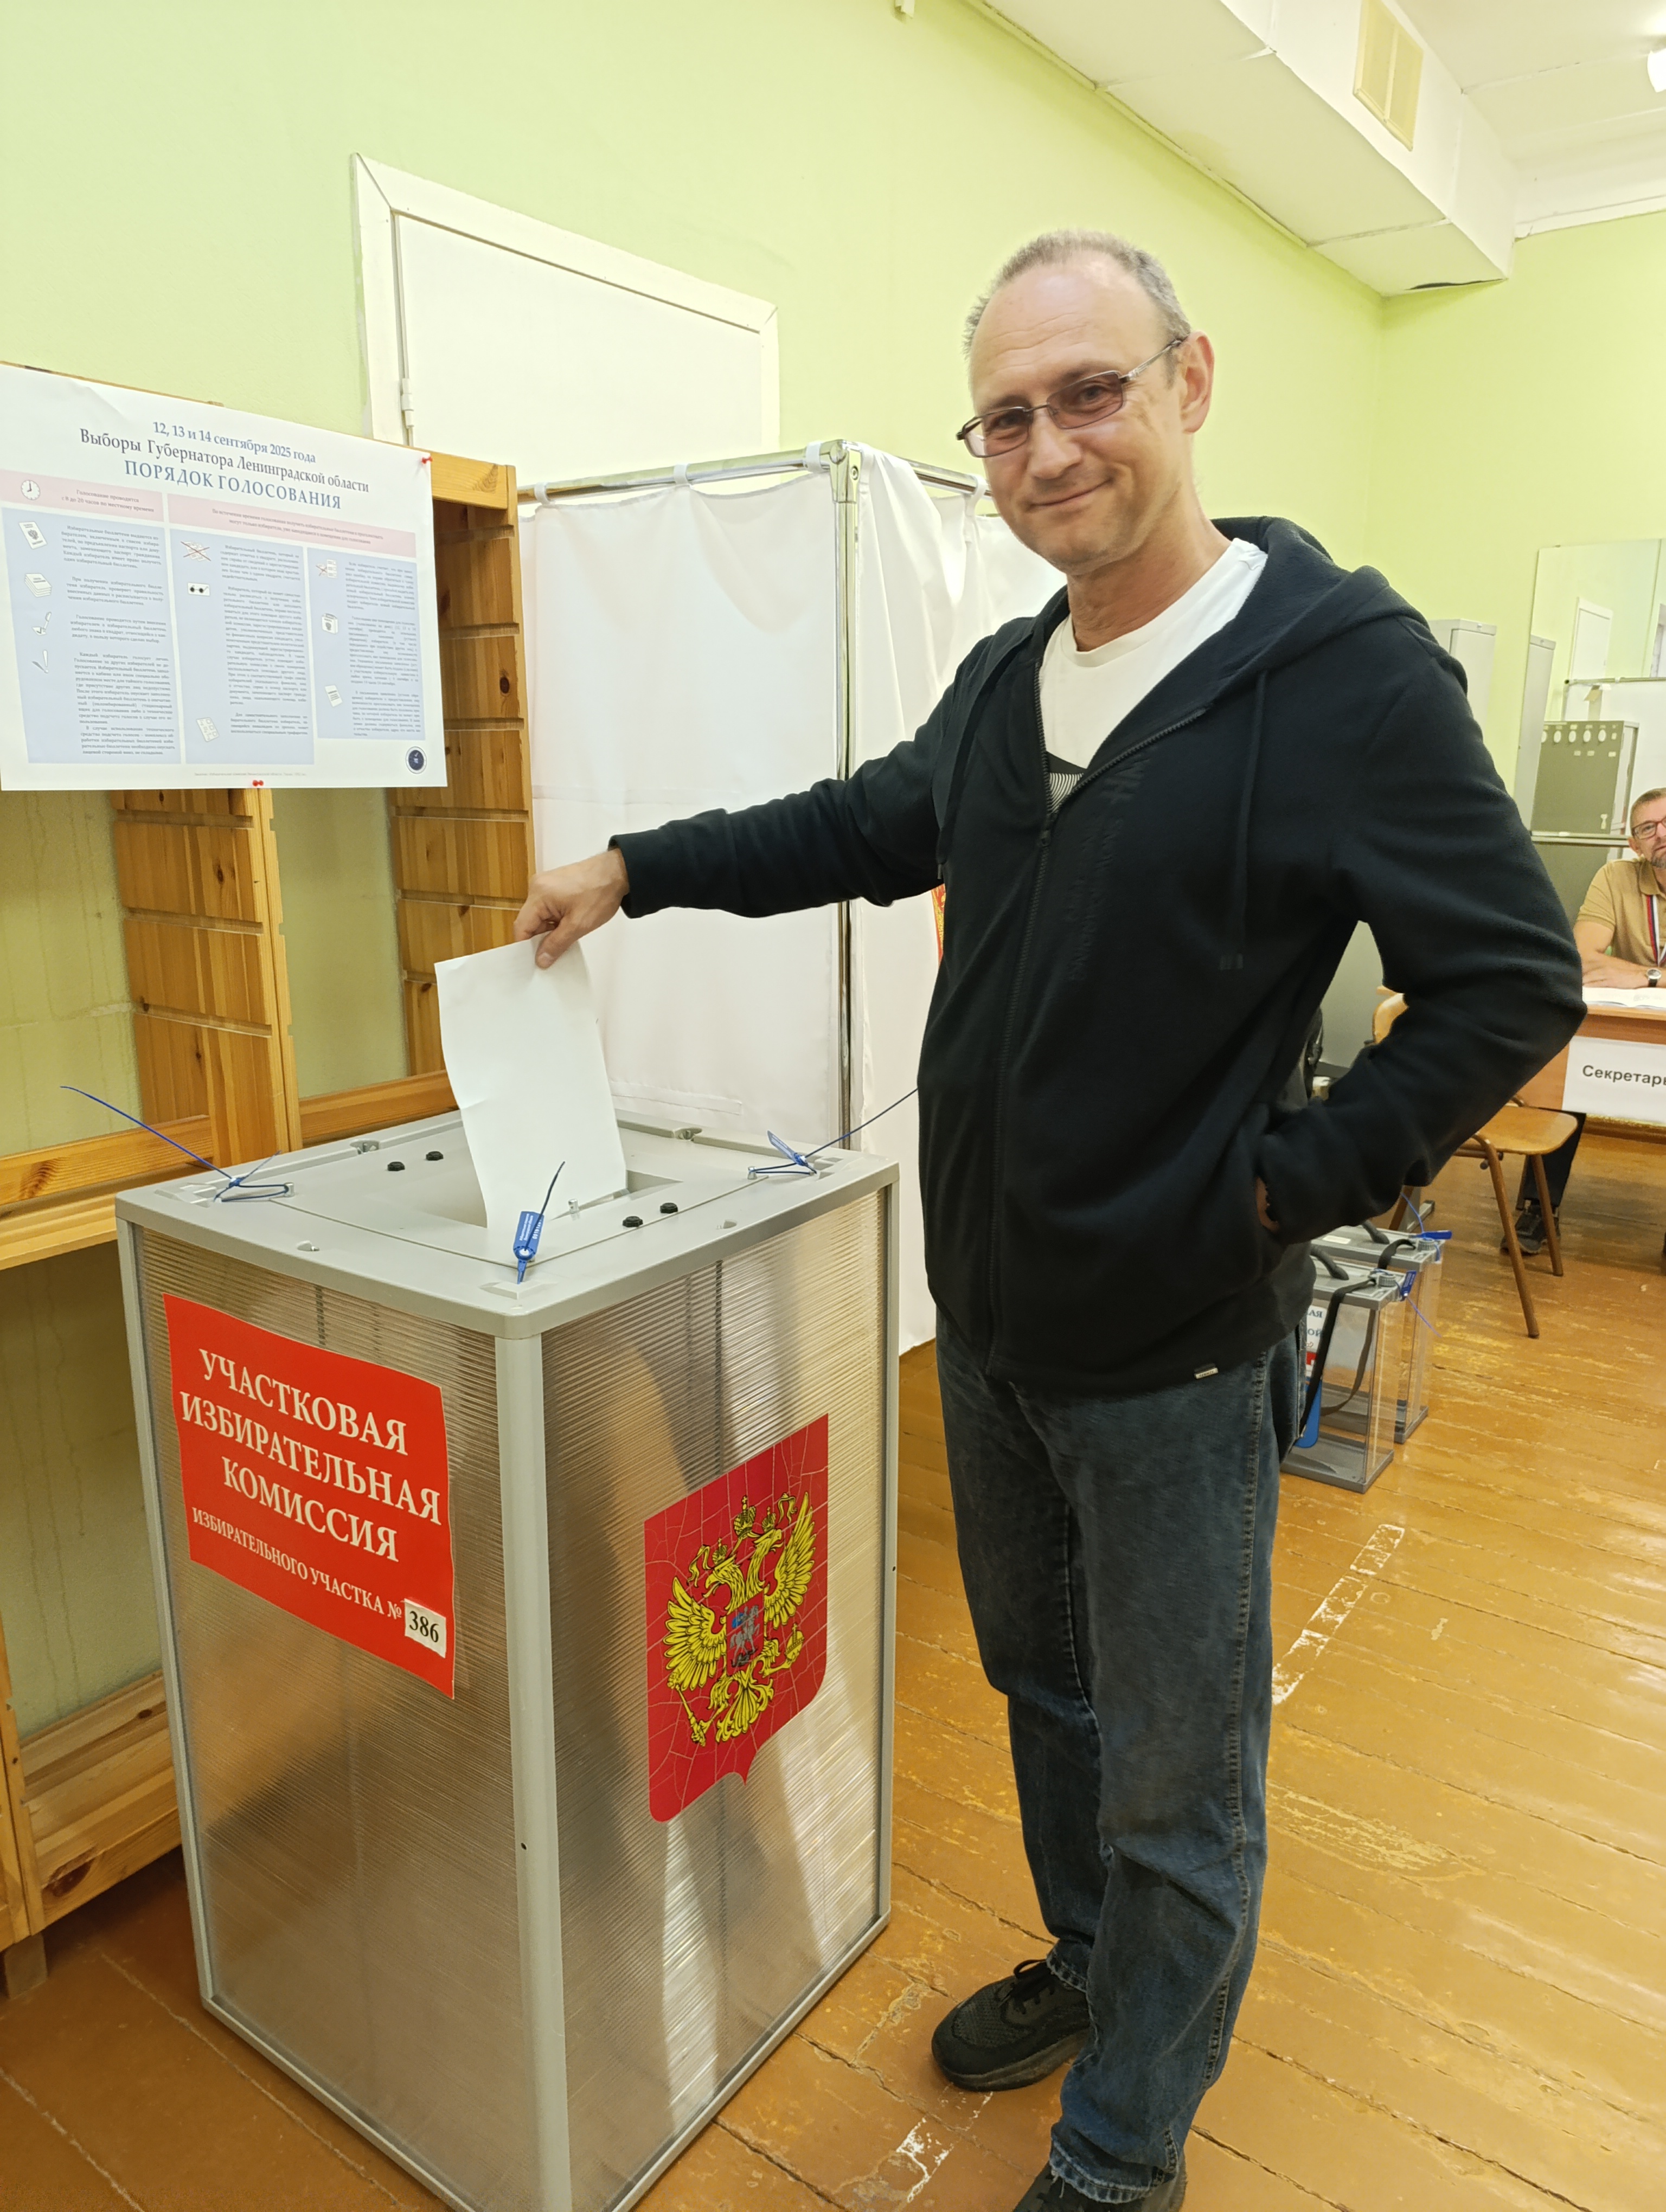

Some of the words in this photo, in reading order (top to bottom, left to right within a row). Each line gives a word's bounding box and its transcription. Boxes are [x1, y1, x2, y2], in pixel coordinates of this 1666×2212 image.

[80, 428, 142, 453] Выборы
[147, 440, 233, 470] Губернатора
[237, 456, 325, 484] Ленинградской
[328, 475, 369, 492] области
[153, 422, 169, 436] 12,
[172, 425, 185, 437] 13
[188, 430, 197, 440] и
[199, 430, 212, 442] 14
[214, 435, 267, 455] сентября
[270, 444, 291, 457] 2025
[293, 450, 316, 463] года
[76, 490, 108, 498] Голосование
[125, 460, 214, 487] ПОРЯДОК
[218, 475, 341, 509] ГОЛОСОВАНИЯ
[1308, 1309, 1322, 1318] АЯ
[199, 1348, 408, 1456] УЧАСТКОВАЯ
[180, 1391, 441, 1526] ИЗБИРАТЕЛЬНАЯ
[222, 1456, 399, 1562] КОМИССИЯ
[192, 1507, 308, 1580] ИЗБИРАТЕЛЬНОГО
[309, 1567, 385, 1616] УЧАСТКА
[387, 1600, 402, 1620] №
[409, 1610, 439, 1643] 386
